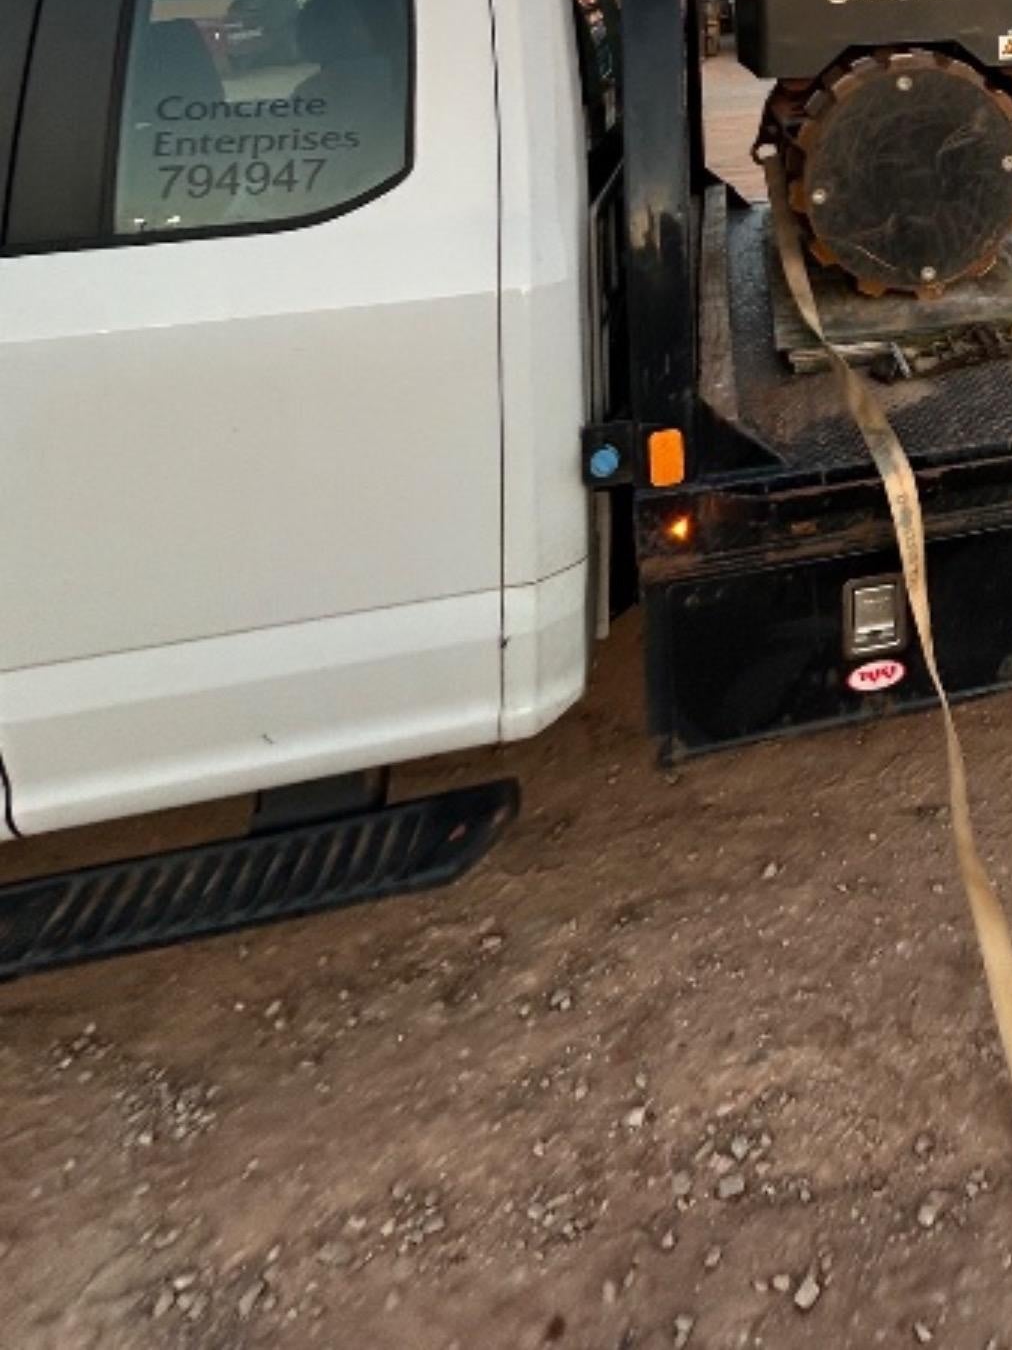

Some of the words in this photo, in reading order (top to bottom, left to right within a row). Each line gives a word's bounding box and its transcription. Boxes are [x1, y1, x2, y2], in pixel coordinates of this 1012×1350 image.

[156, 96, 327, 121] Concrete
[154, 129, 360, 159] Enterprises
[157, 158, 327, 200] 794947
